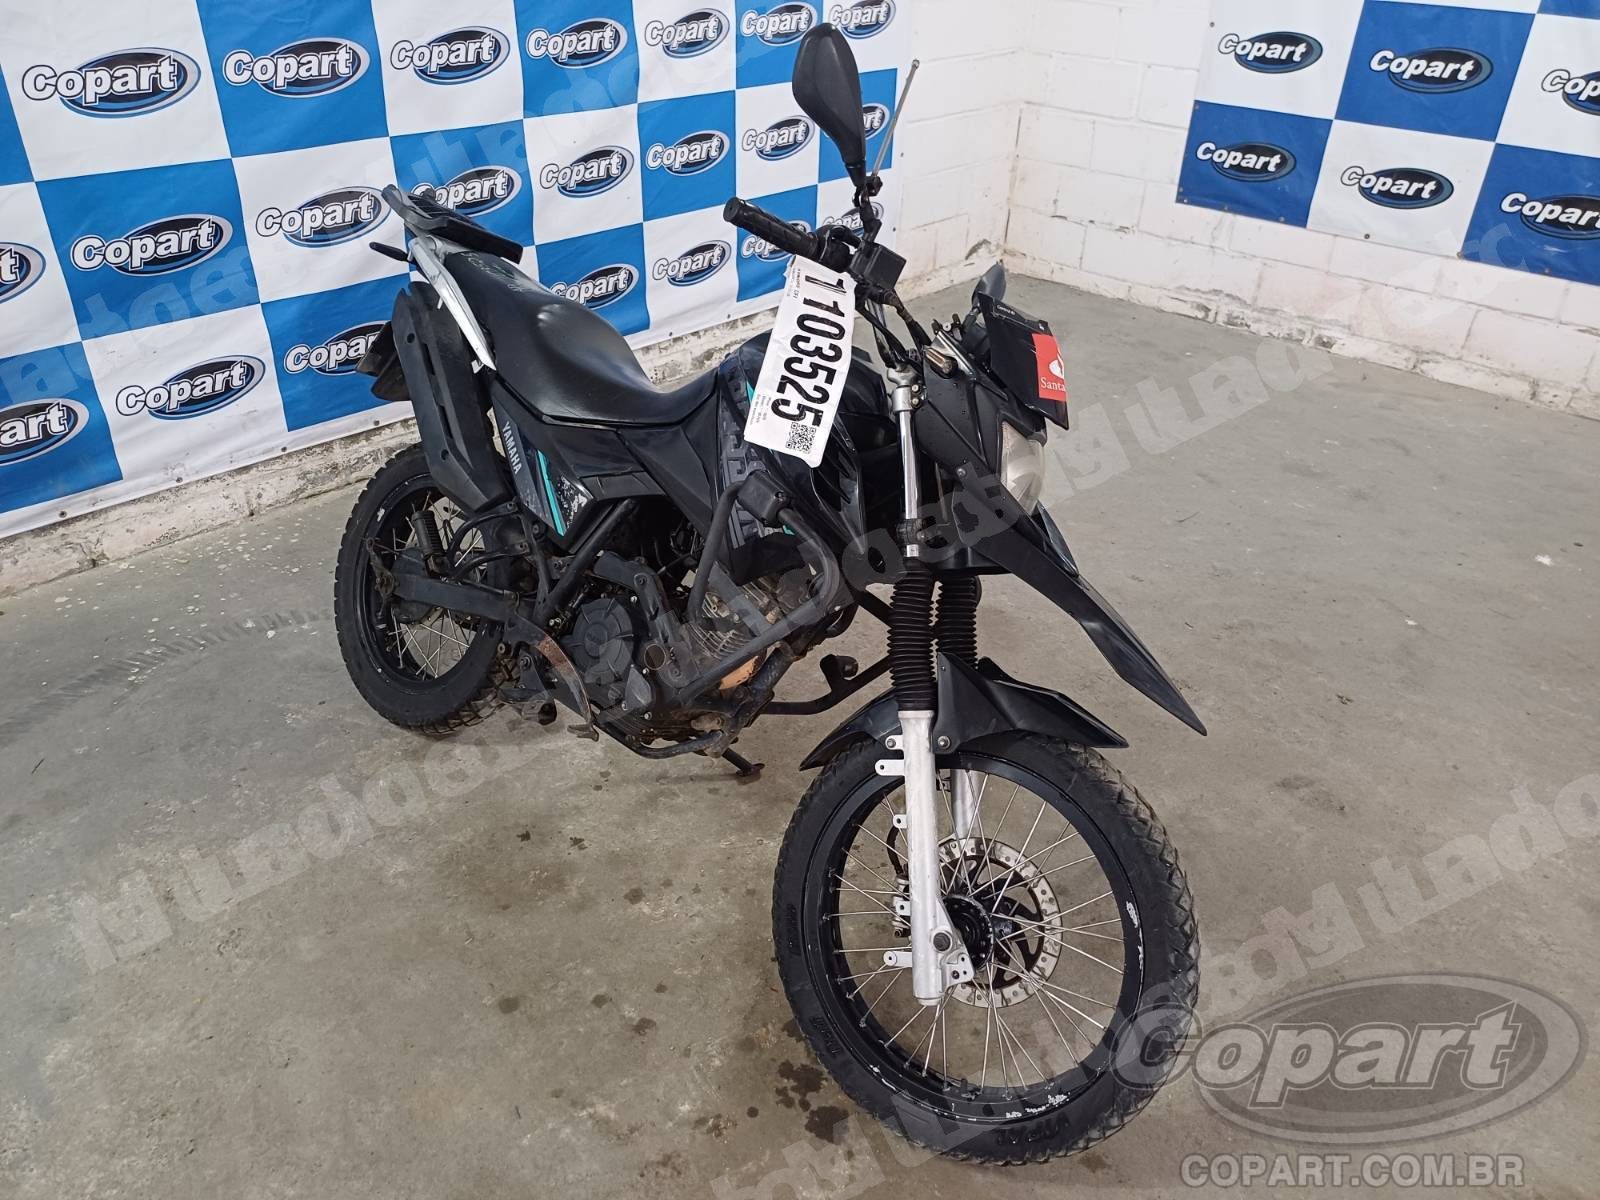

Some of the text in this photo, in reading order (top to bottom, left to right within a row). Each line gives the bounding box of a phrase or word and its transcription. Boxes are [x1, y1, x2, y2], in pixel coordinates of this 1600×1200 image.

[645, 13, 720, 49] Copart
[741, 6, 811, 36] Copart
[828, 1, 890, 31] Copart
[390, 33, 496, 74] Copart
[526, 24, 616, 61] Copart
[1218, 33, 1308, 62] Copart
[22, 56, 180, 105] Copart
[223, 44, 354, 88] Copart
[1369, 50, 1476, 83] Copart
[646, 135, 722, 170] Copart
[742, 121, 808, 152] Copart
[539, 149, 625, 190] Copart
[1196, 141, 1282, 173] Copart
[1341, 165, 1438, 200] Copart
[256, 191, 376, 238] Copart
[1500, 192, 1600, 229] Copar
[70, 218, 216, 271] Copart
[653, 242, 725, 281] Copart
[770, 275, 847, 427] 1103525
[115, 361, 248, 417] Copart
[502, 420, 521, 475] YAMAHA
